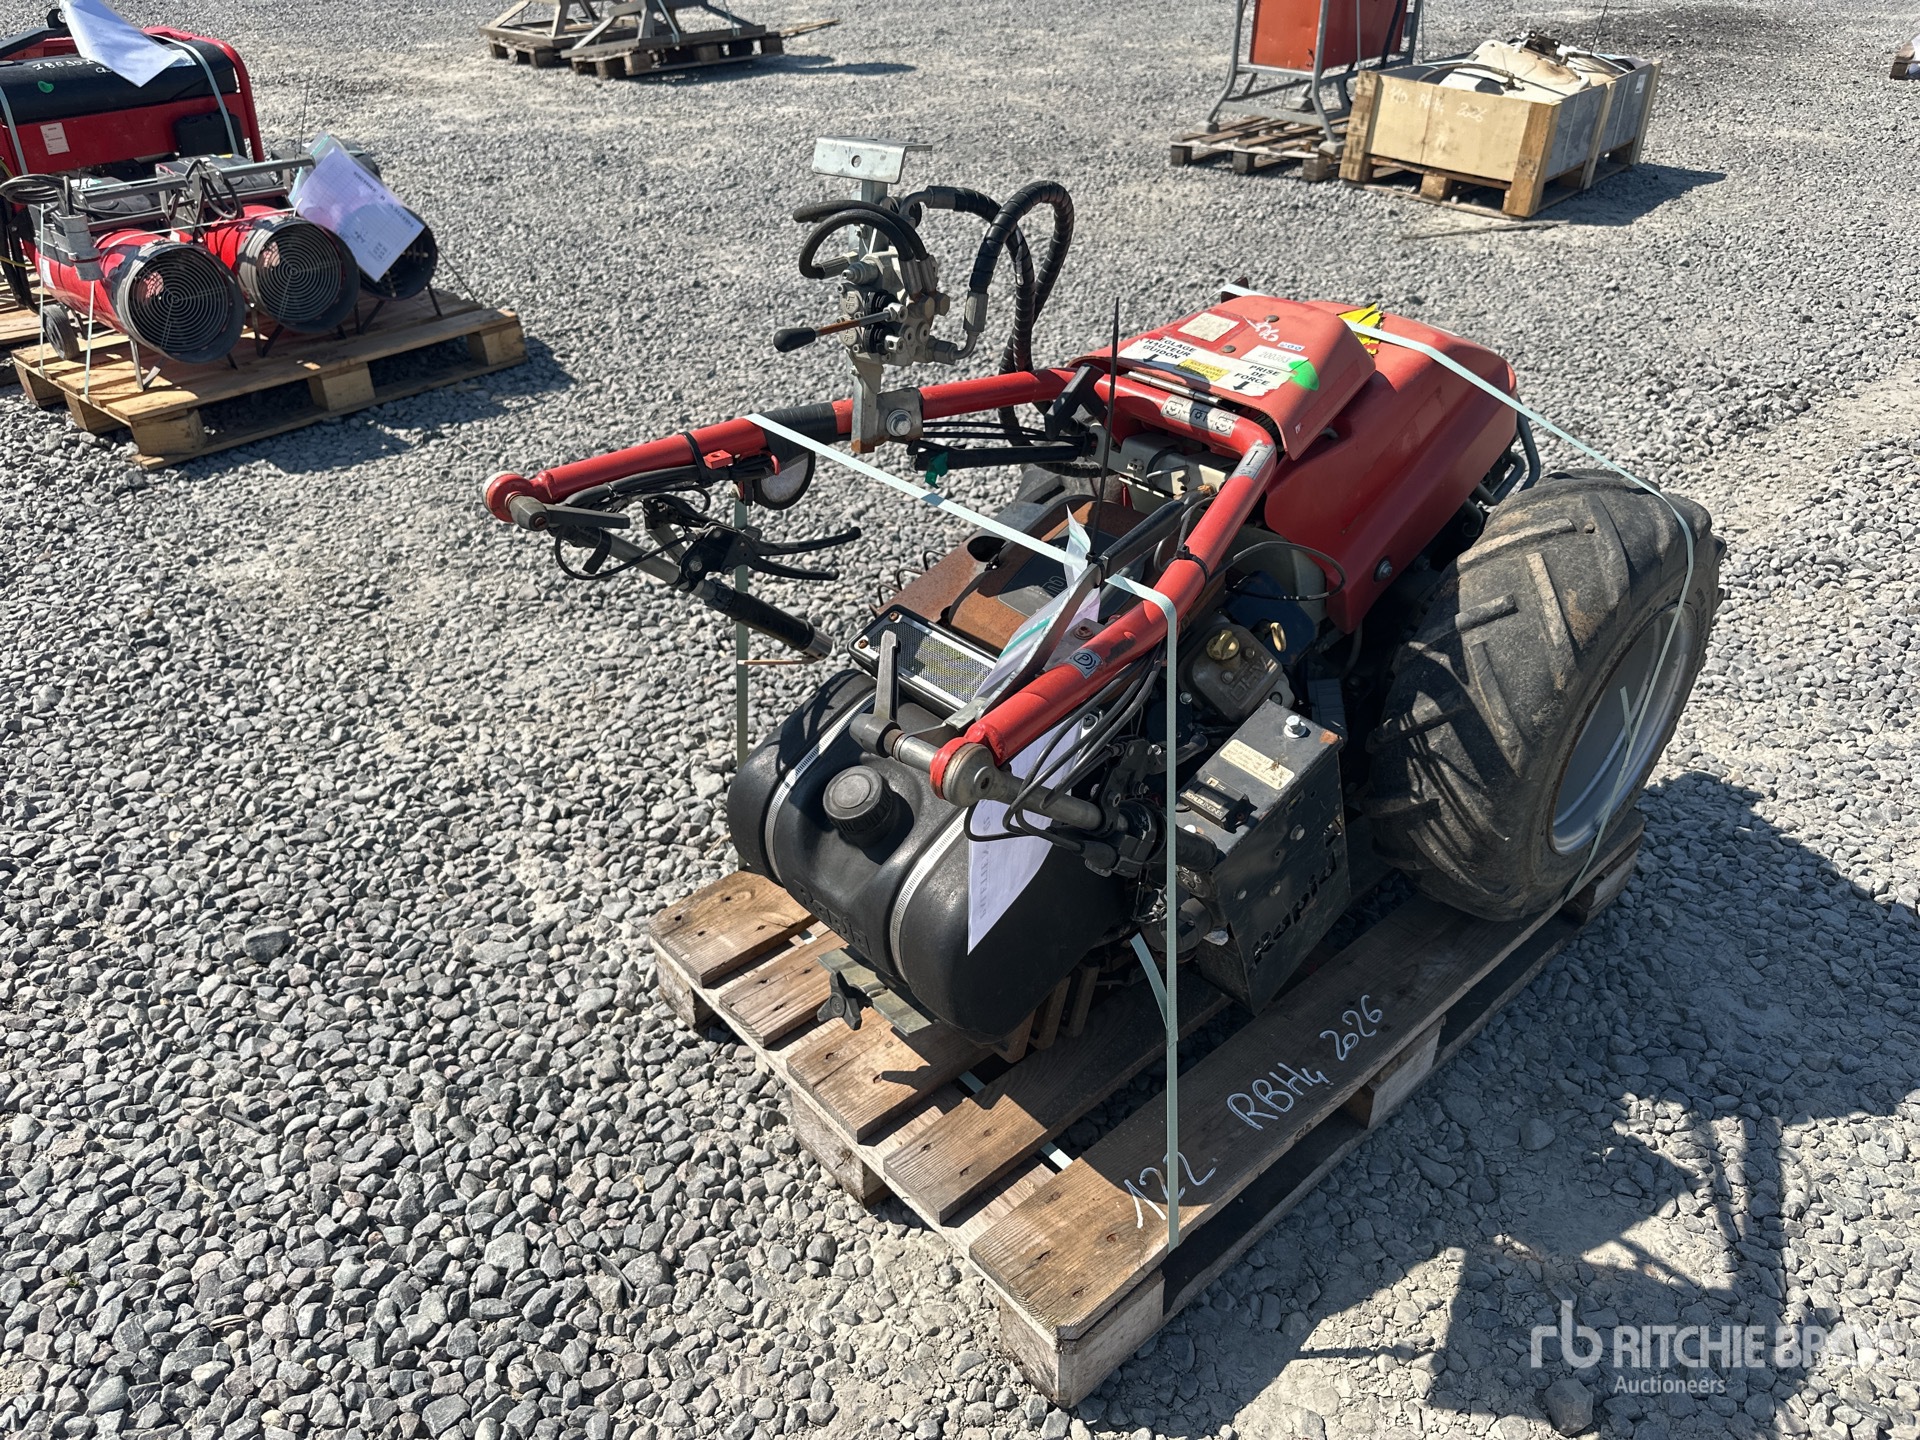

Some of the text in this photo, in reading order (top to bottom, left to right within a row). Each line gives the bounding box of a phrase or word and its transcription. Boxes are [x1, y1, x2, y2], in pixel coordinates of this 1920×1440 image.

[1142, 345, 1181, 359] GUIDON
[1145, 340, 1192, 357] HAUTEUR
[1249, 365, 1281, 377] PRISE
[1251, 371, 1266, 379] DE
[1234, 373, 1270, 386] FORCE
[1253, 851, 1337, 966] Rapid
[1227, 1062, 1333, 1131] RBH4
[1319, 994, 1383, 1062] 2026
